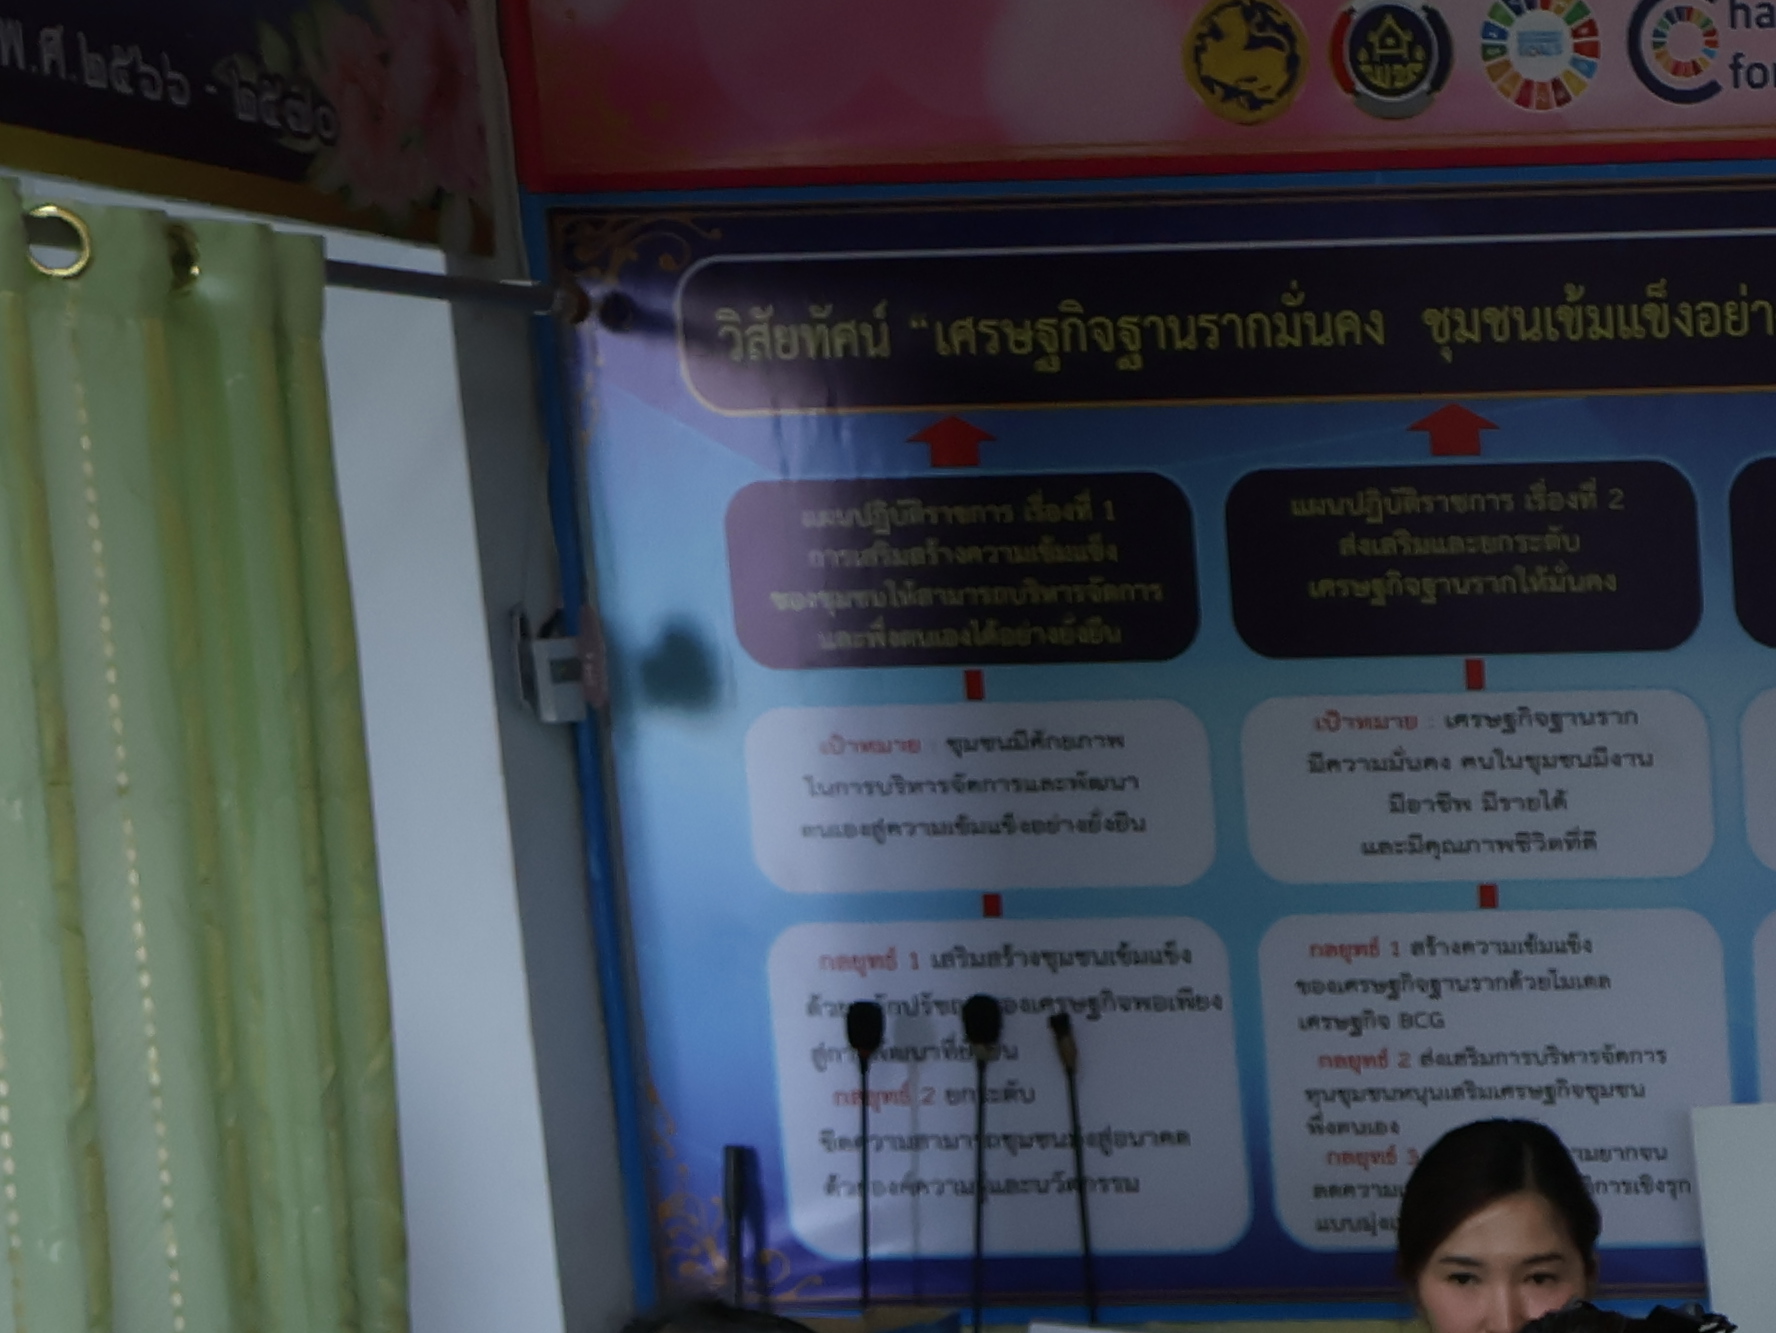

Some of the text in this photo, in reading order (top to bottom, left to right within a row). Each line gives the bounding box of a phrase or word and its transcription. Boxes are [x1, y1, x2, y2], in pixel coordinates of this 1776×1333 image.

[716, 300, 892, 362] วิสัยทัศน์
[1608, 489, 1624, 510] 2
[1105, 500, 1114, 520] 1
[1399, 1011, 1445, 1030] BCG
[1399, 1053, 1411, 1068] 2
